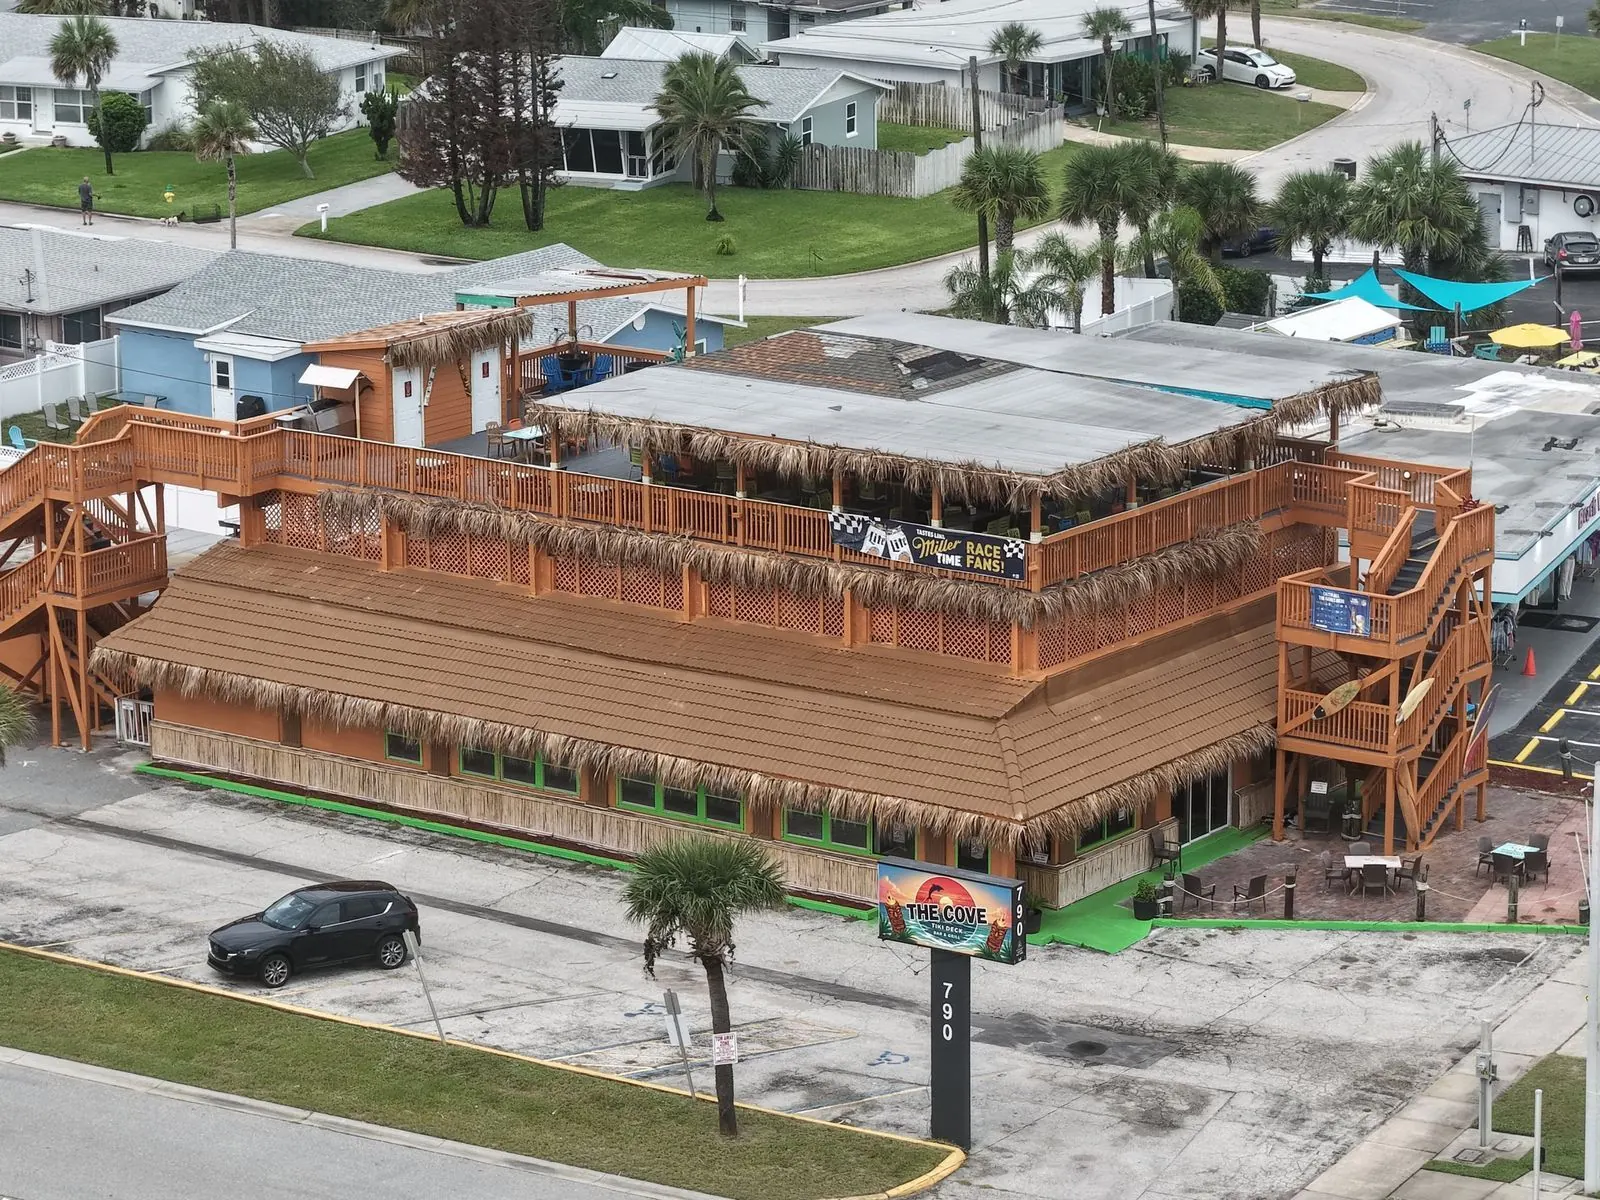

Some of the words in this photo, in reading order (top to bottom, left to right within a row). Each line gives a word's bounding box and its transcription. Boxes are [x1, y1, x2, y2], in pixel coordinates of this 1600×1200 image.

[916, 529, 933, 538] TASTES
[912, 536, 962, 559] Miller
[966, 541, 1001, 559] RACE
[936, 552, 962, 567] TIME
[966, 554, 1005, 574] FANS!
[906, 903, 939, 921] THE
[943, 904, 988, 925] COVE
[931, 922, 944, 931] TIKI
[945, 925, 963, 934] DECK
[942, 982, 953, 1041] 790
